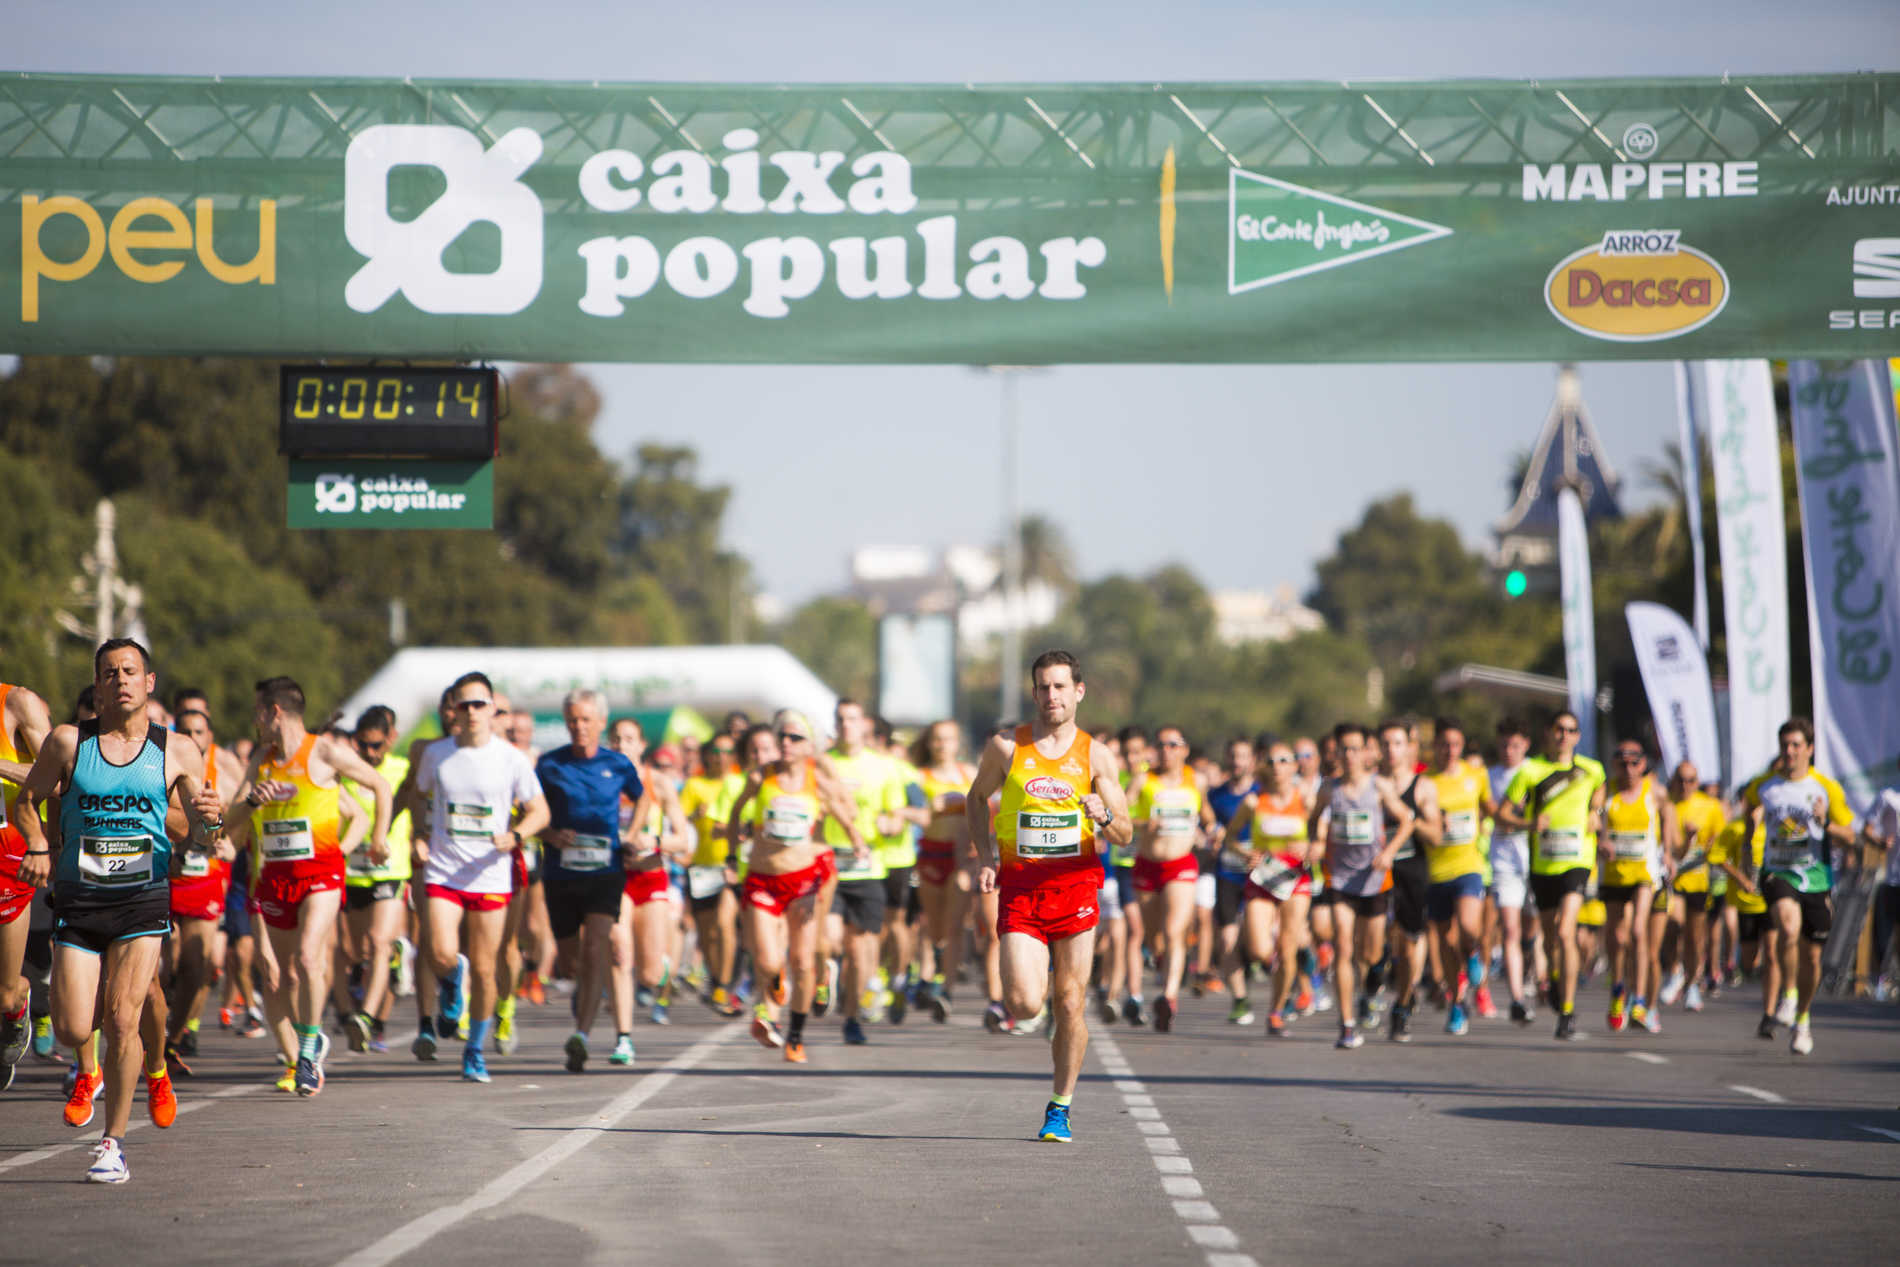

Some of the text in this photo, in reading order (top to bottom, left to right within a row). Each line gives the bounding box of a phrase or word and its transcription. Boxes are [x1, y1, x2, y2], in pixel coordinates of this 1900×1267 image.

[578, 128, 918, 214] caixa
[1522, 161, 1759, 202] MAPFRE
[1826, 185, 1900, 206] AJUNT
[1237, 214, 1260, 241] El
[1261, 215, 1312, 241] Corte
[1603, 234, 1676, 254] ARROZ
[21, 194, 276, 322] peu
[578, 215, 1107, 318] popular
[1568, 269, 1712, 308] Dacsa
[294, 378, 480, 419] 0:00:14
[360, 474, 429, 492] caixa
[360, 489, 466, 513] popular
[78, 793, 153, 813] CRESPO
[84, 816, 144, 830] RUNNERS
[1042, 832, 1057, 844] 18
[108, 859, 127, 872] 22
